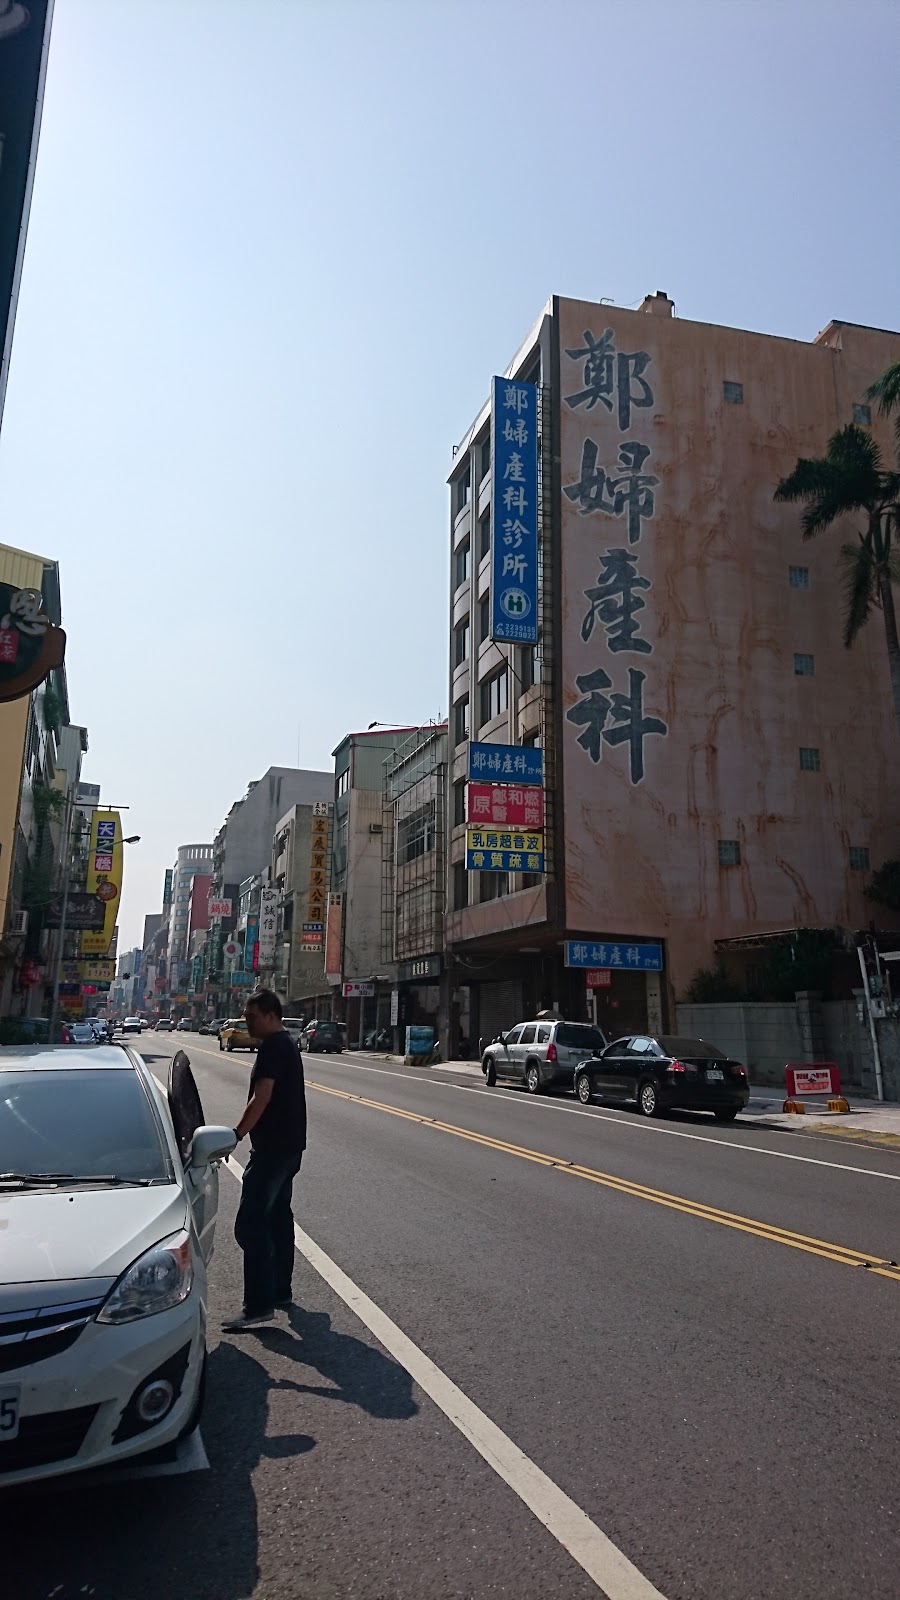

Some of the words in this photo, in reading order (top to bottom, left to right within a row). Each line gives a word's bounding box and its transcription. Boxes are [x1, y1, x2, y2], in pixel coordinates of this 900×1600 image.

[501, 384, 530, 583] 鄭婦產科診所
[563, 328, 667, 785] 鄭婦產科
[472, 833, 539, 850] 乳房超音波
[472, 852, 539, 869] 骨質疏鬆
